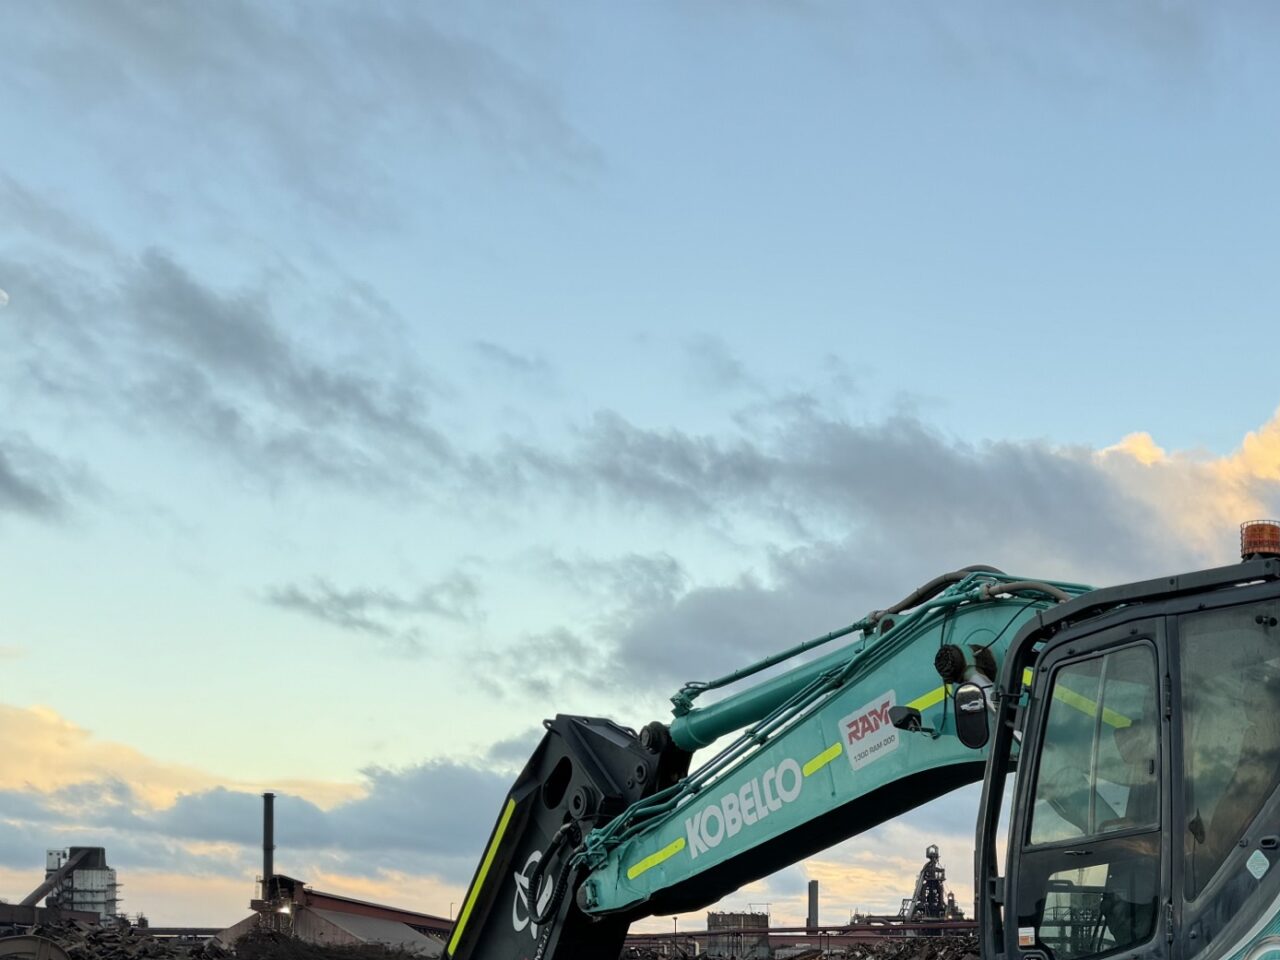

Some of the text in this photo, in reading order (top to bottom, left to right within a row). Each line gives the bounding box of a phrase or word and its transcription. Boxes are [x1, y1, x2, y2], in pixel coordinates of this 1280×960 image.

[846, 700, 890, 745] RAM
[853, 734, 896, 762] 1300 RAM 000
[685, 758, 802, 860] KOBELCO
